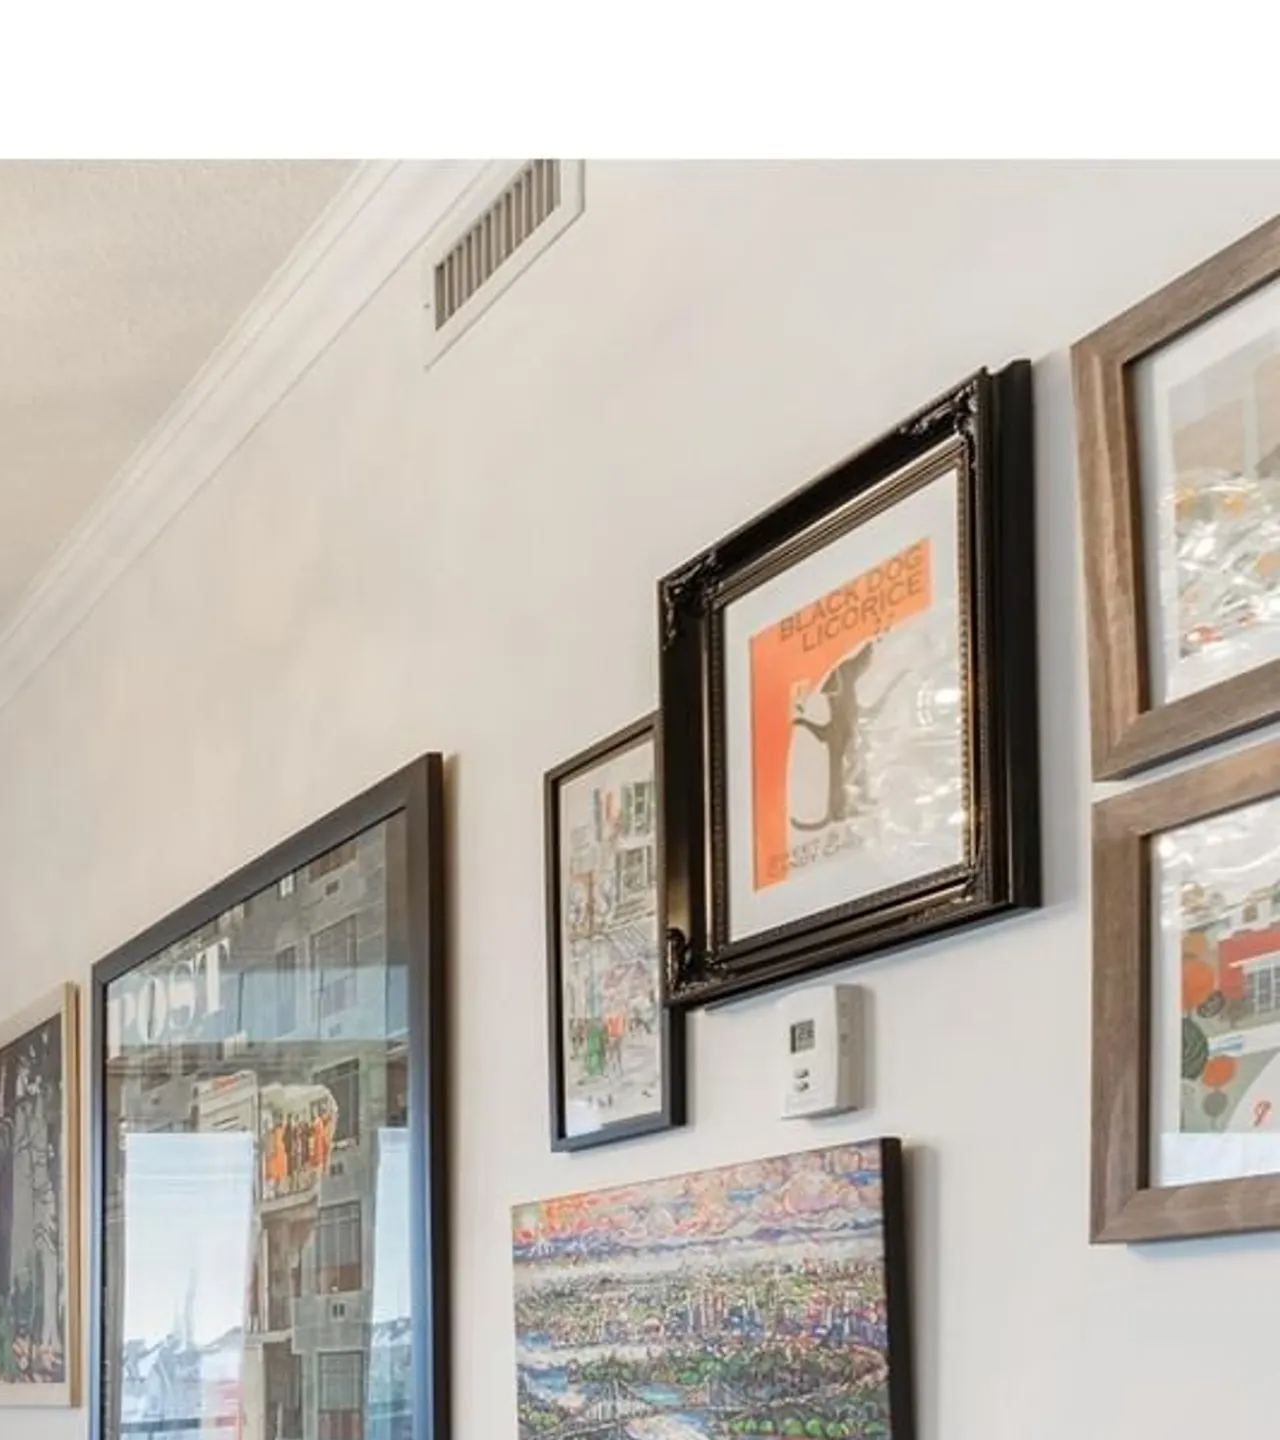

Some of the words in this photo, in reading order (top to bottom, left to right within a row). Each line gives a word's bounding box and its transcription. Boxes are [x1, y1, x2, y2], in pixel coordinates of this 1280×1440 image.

[779, 584, 860, 642] BLACK
[868, 544, 922, 594] DOG
[802, 573, 923, 653] LICORICE
